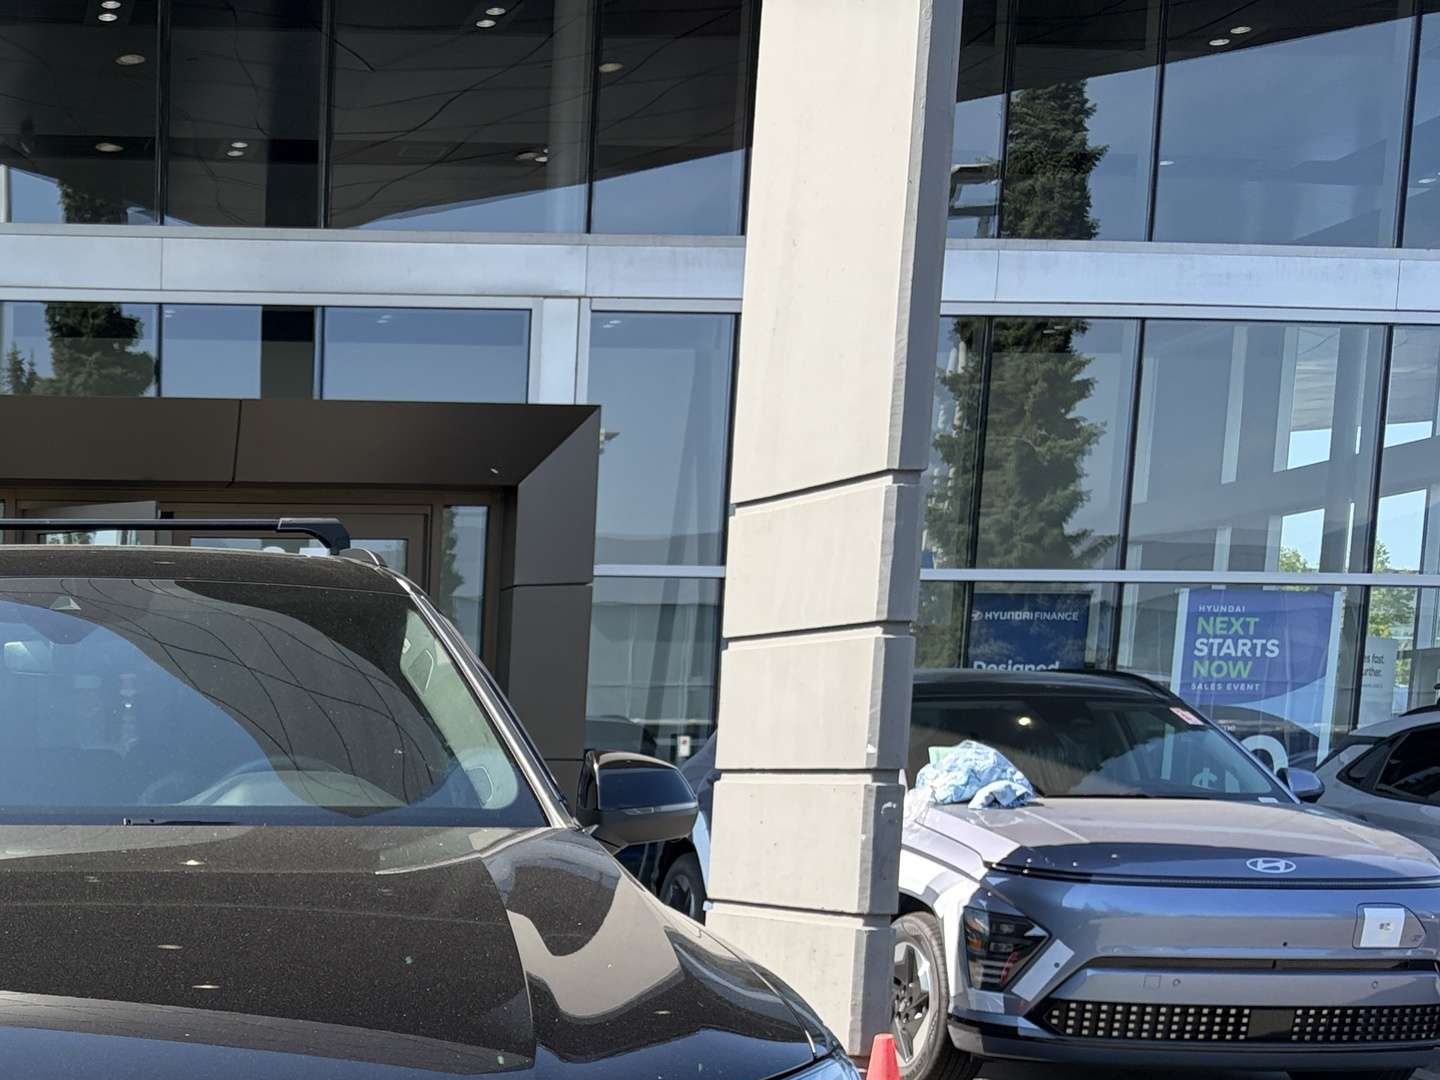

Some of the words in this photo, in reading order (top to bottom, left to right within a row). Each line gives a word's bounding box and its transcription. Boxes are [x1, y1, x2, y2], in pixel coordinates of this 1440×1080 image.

[984, 611, 1033, 620] HYUNDAI
[1034, 611, 1079, 621] FINANCE
[1196, 617, 1259, 635] NEXT
[1193, 638, 1280, 658] STARTS
[1192, 660, 1253, 678] NOW
